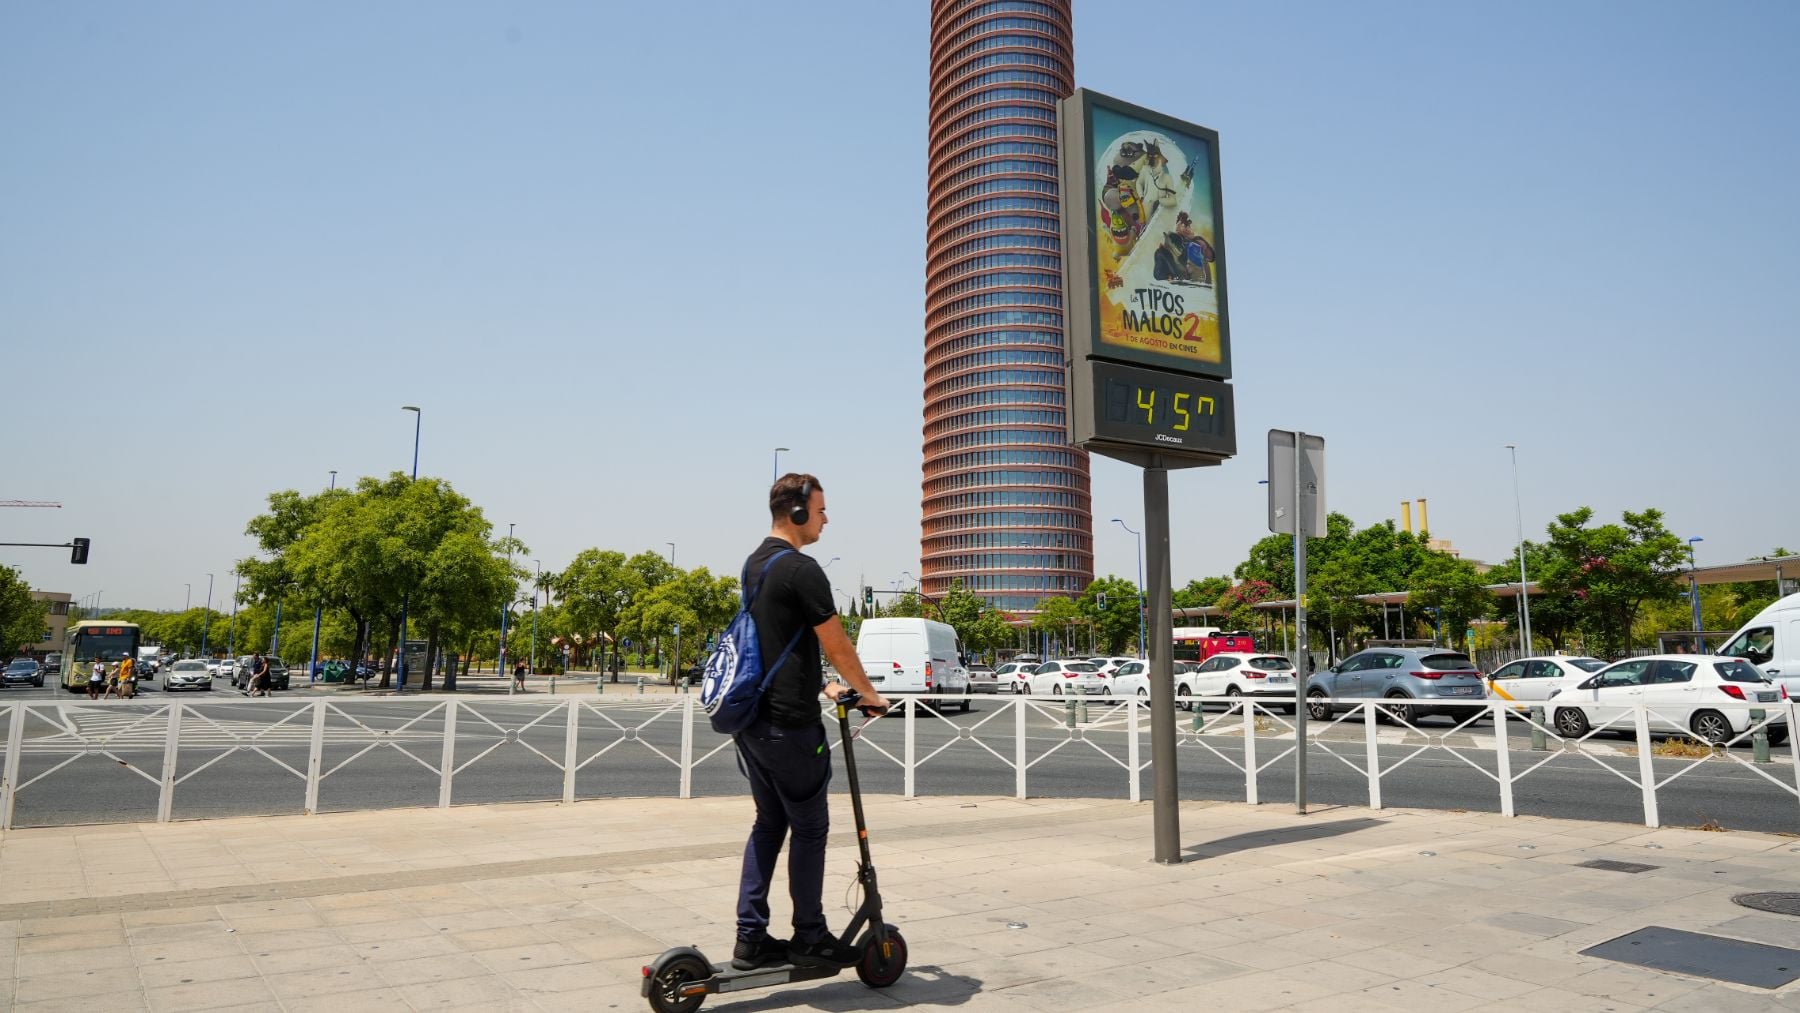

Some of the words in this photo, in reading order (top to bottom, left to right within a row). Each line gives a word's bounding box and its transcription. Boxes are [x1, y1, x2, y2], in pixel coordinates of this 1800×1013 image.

[1134, 288, 1184, 316] TIPOS
[1122, 309, 1183, 339] MALOS
[1183, 312, 1203, 343] 2
[1130, 335, 1138, 343] DE
[1139, 336, 1168, 348] AGOSTO
[1169, 342, 1178, 350] EN
[1178, 343, 1198, 354] CINES
[1155, 434, 1183, 444] JCDecaux
